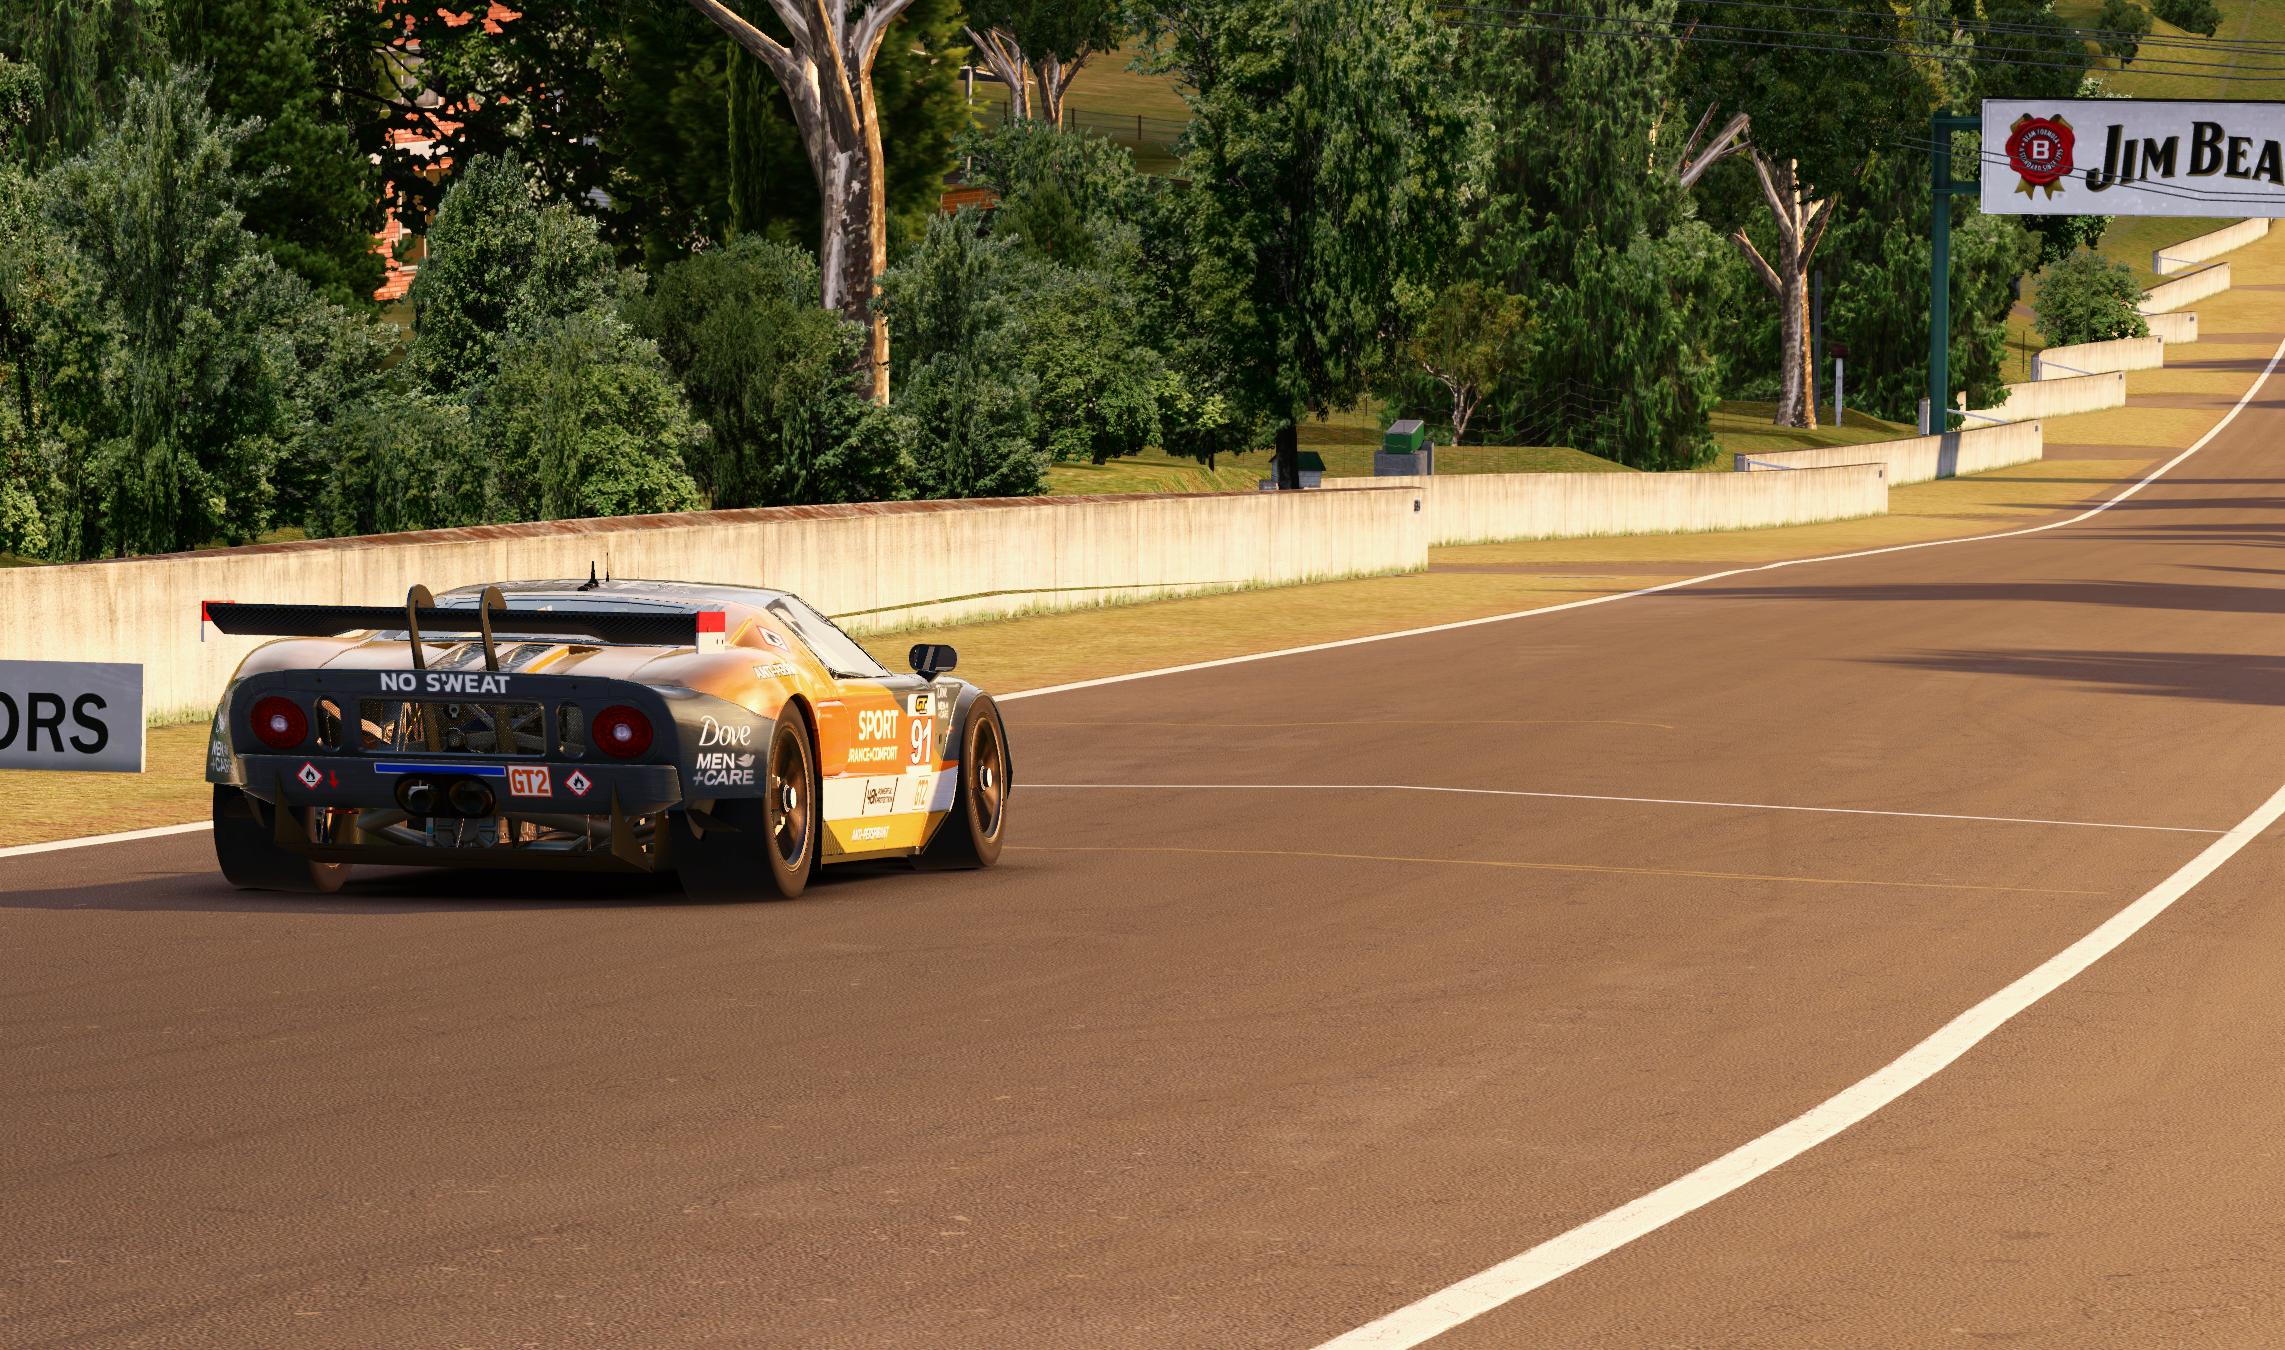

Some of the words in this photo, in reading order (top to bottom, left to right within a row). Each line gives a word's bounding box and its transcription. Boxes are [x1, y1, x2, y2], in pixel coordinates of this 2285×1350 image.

[2033, 140, 2050, 159] B
[2086, 124, 2180, 192] JIM
[2186, 121, 2284, 186] BEA
[380, 672, 417, 691] NO
[426, 673, 510, 694] SWEAT
[699, 715, 751, 746] Dove
[858, 709, 899, 741] SPORT
[911, 718, 932, 765] 91
[696, 753, 735, 769] MEN
[511, 769, 549, 794] GT2
[693, 769, 755, 786] +CARE
